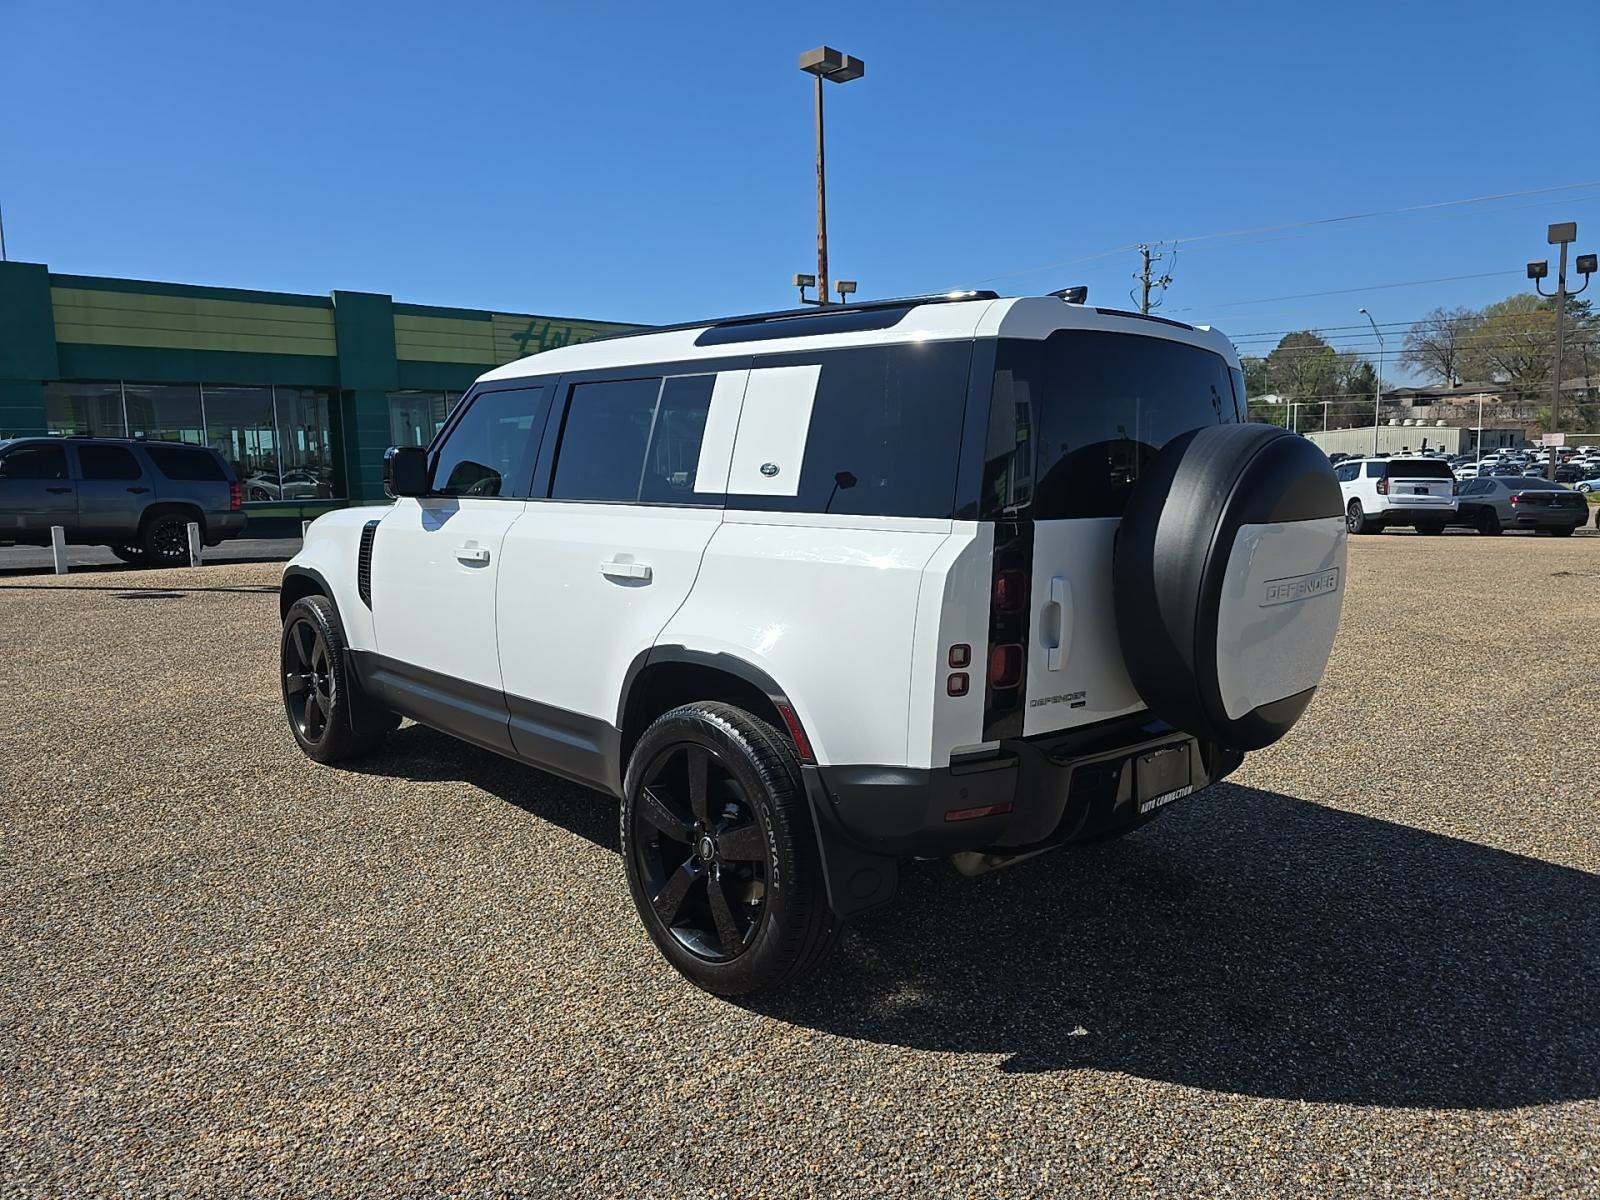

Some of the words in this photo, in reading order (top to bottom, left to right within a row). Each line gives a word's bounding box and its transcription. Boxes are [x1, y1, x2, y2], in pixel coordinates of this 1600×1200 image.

[1265, 575, 1335, 601] DEFENDER
[1029, 690, 1087, 708] DEFENDER
[1140, 798, 1156, 814] AUTO
[1156, 784, 1194, 807] CONNECTION
